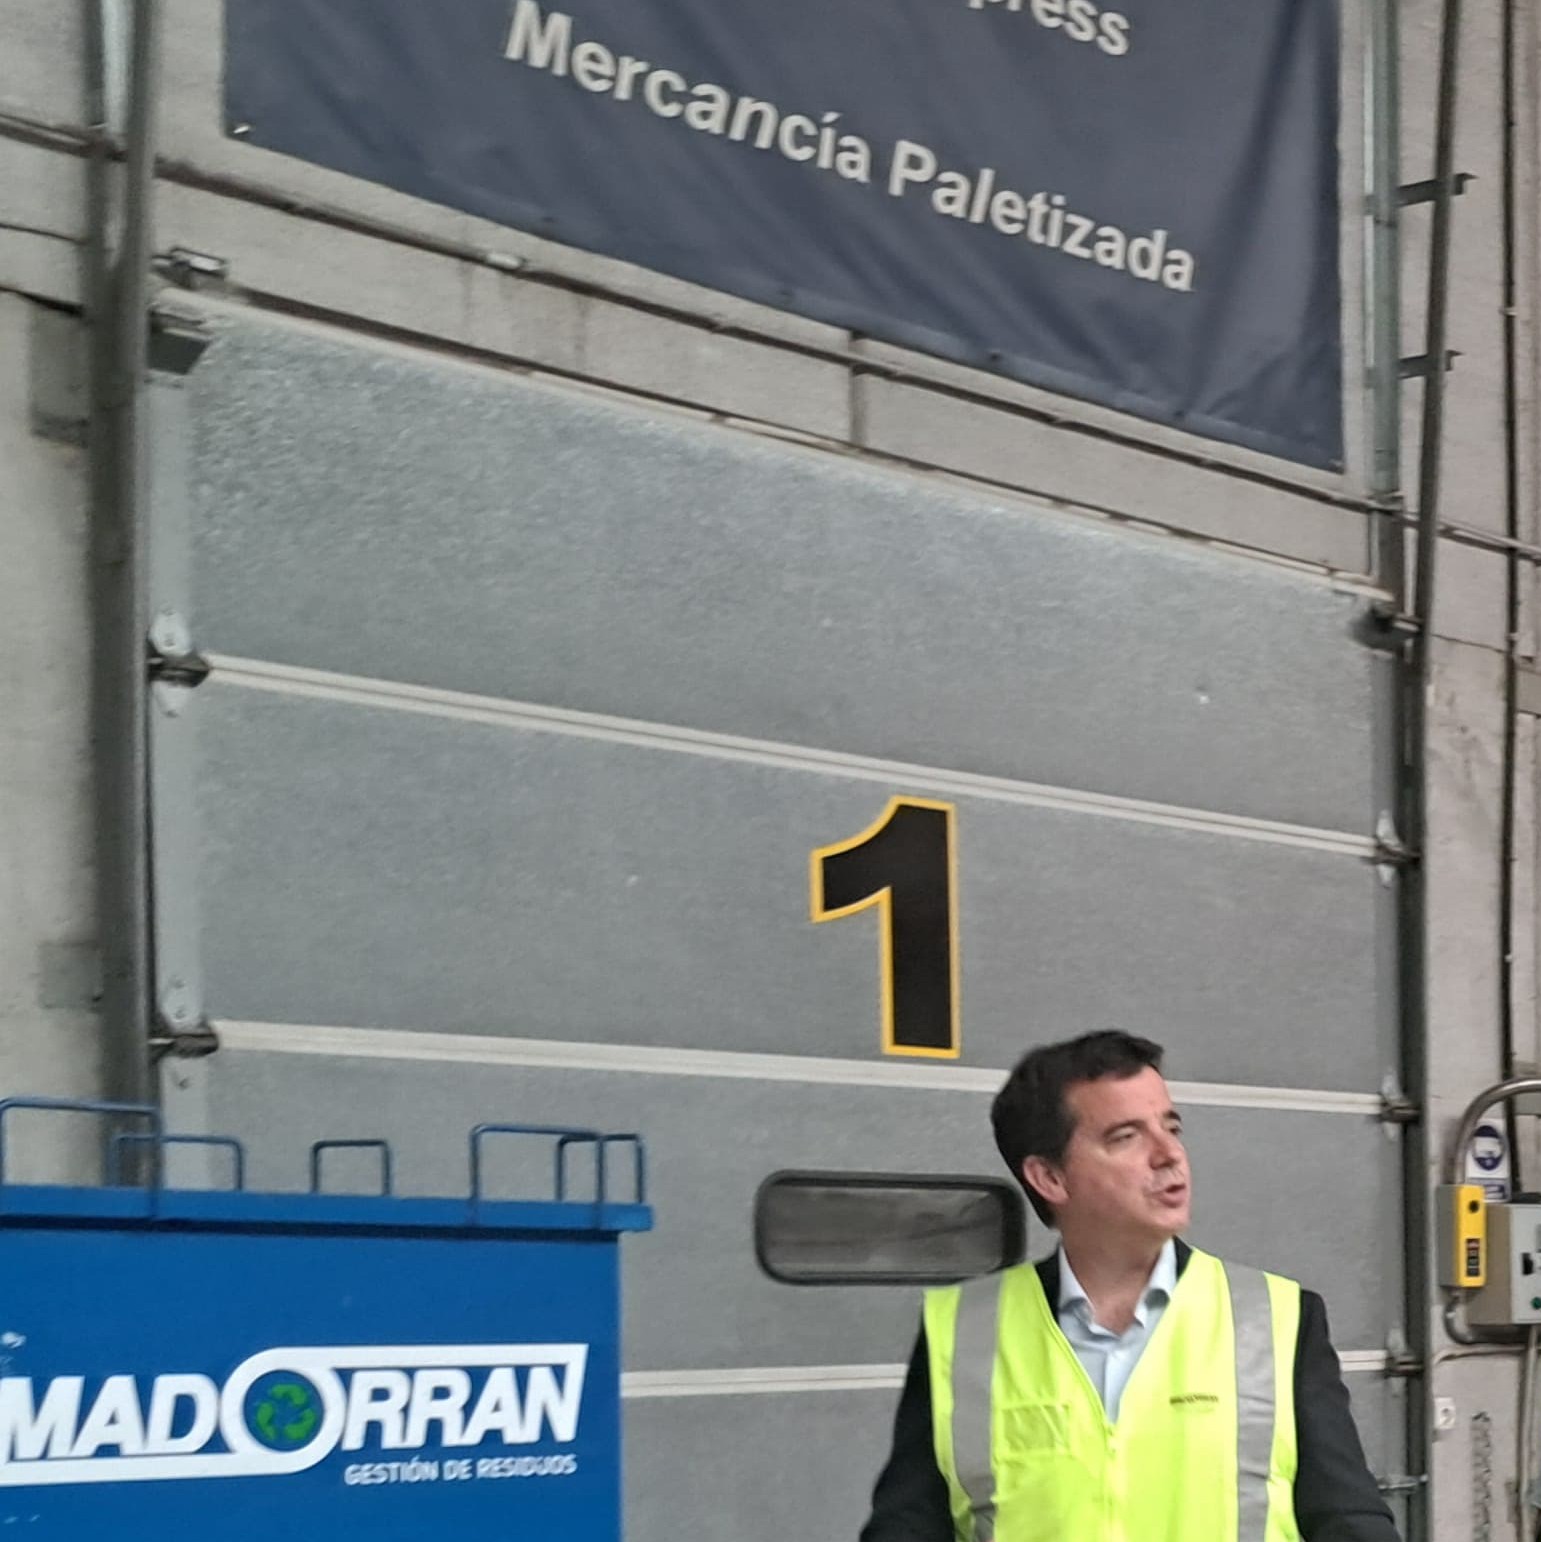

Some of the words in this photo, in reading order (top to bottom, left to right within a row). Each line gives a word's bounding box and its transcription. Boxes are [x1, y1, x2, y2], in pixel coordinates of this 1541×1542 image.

[503, 0, 872, 184] Mercancía
[887, 138, 1194, 292] Paletizada
[810, 795, 960, 1059] 1
[0, 1344, 588, 1485] MADORRAN
[344, 1455, 439, 1486] GESTIÓN
[442, 1458, 473, 1481] DE
[475, 1453, 578, 1479] RESIDUOS
